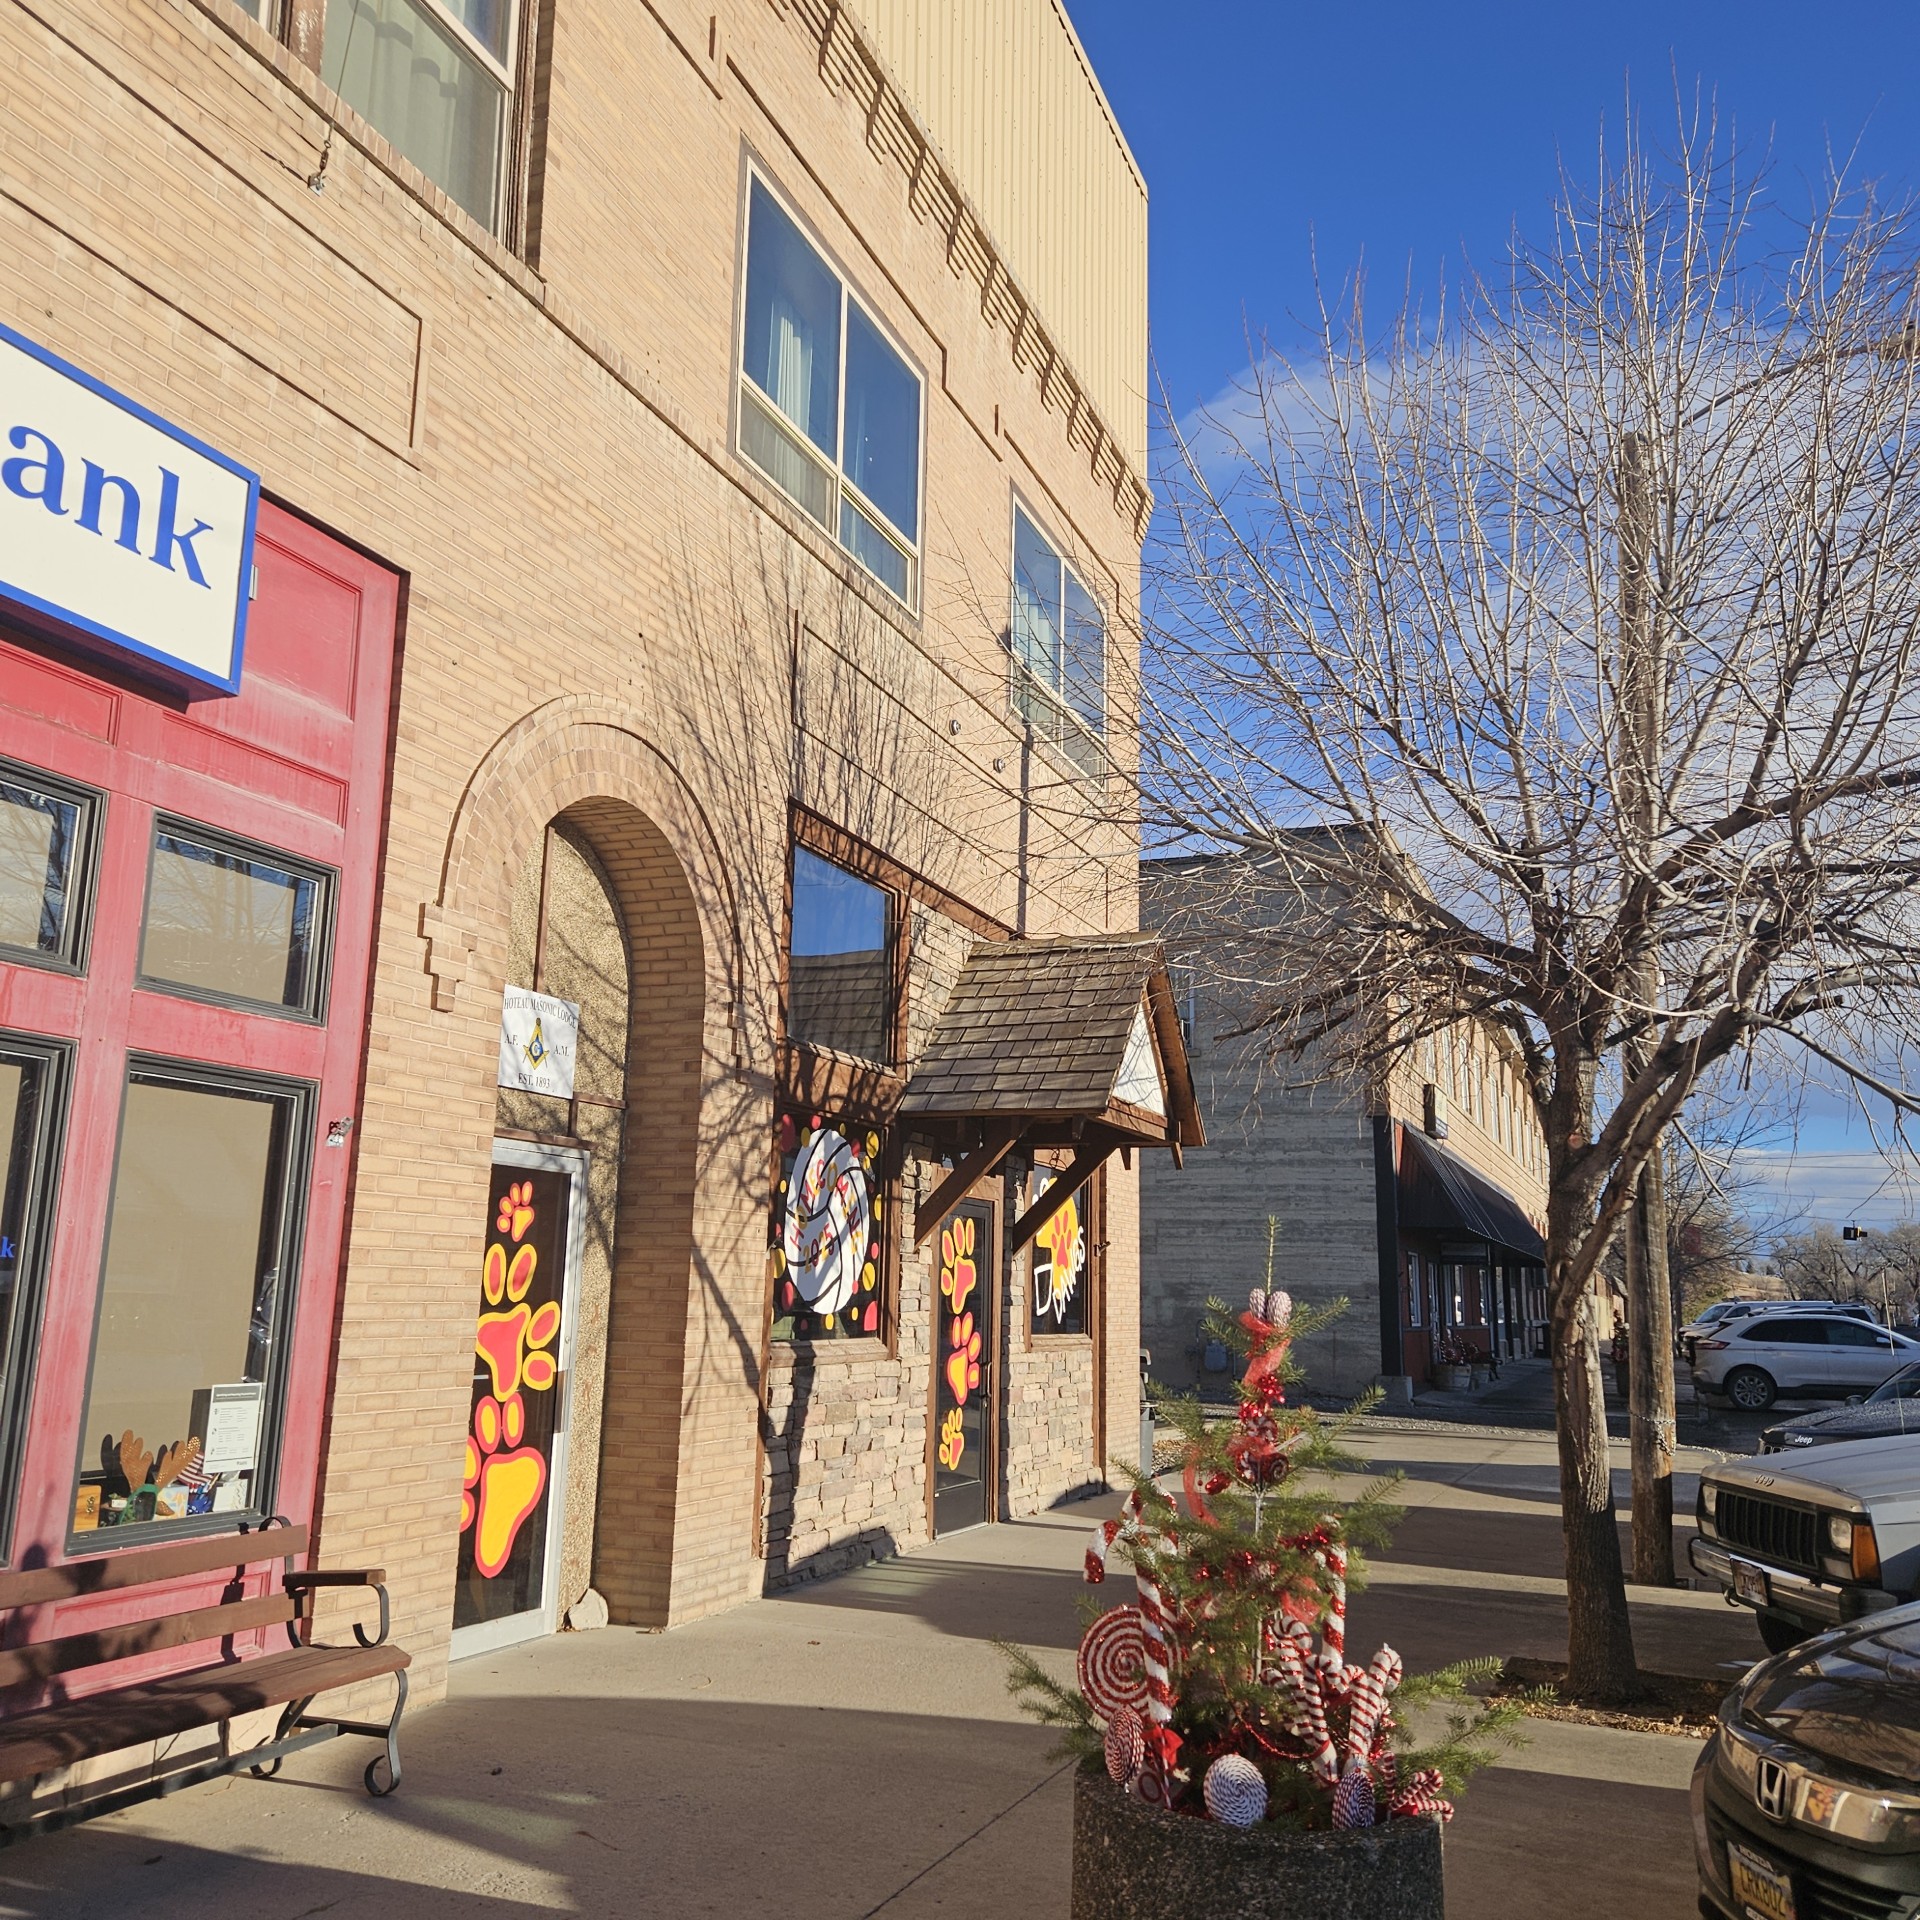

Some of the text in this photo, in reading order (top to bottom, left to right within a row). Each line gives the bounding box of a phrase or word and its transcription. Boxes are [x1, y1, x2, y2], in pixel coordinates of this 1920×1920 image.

[1, 426, 214, 590] ank
[530, 999, 557, 1017] MASONIC
[557, 1008, 577, 1029] LODGE
[504, 1034, 519, 1046] A.F.
[553, 1045, 570, 1057] A.M.
[518, 1073, 551, 1089] EST. 1893
[789, 1158, 864, 1256] HOMECOMING
[804, 1222, 836, 1274] 2025
[1794, 1435, 1813, 1445] Jeep
